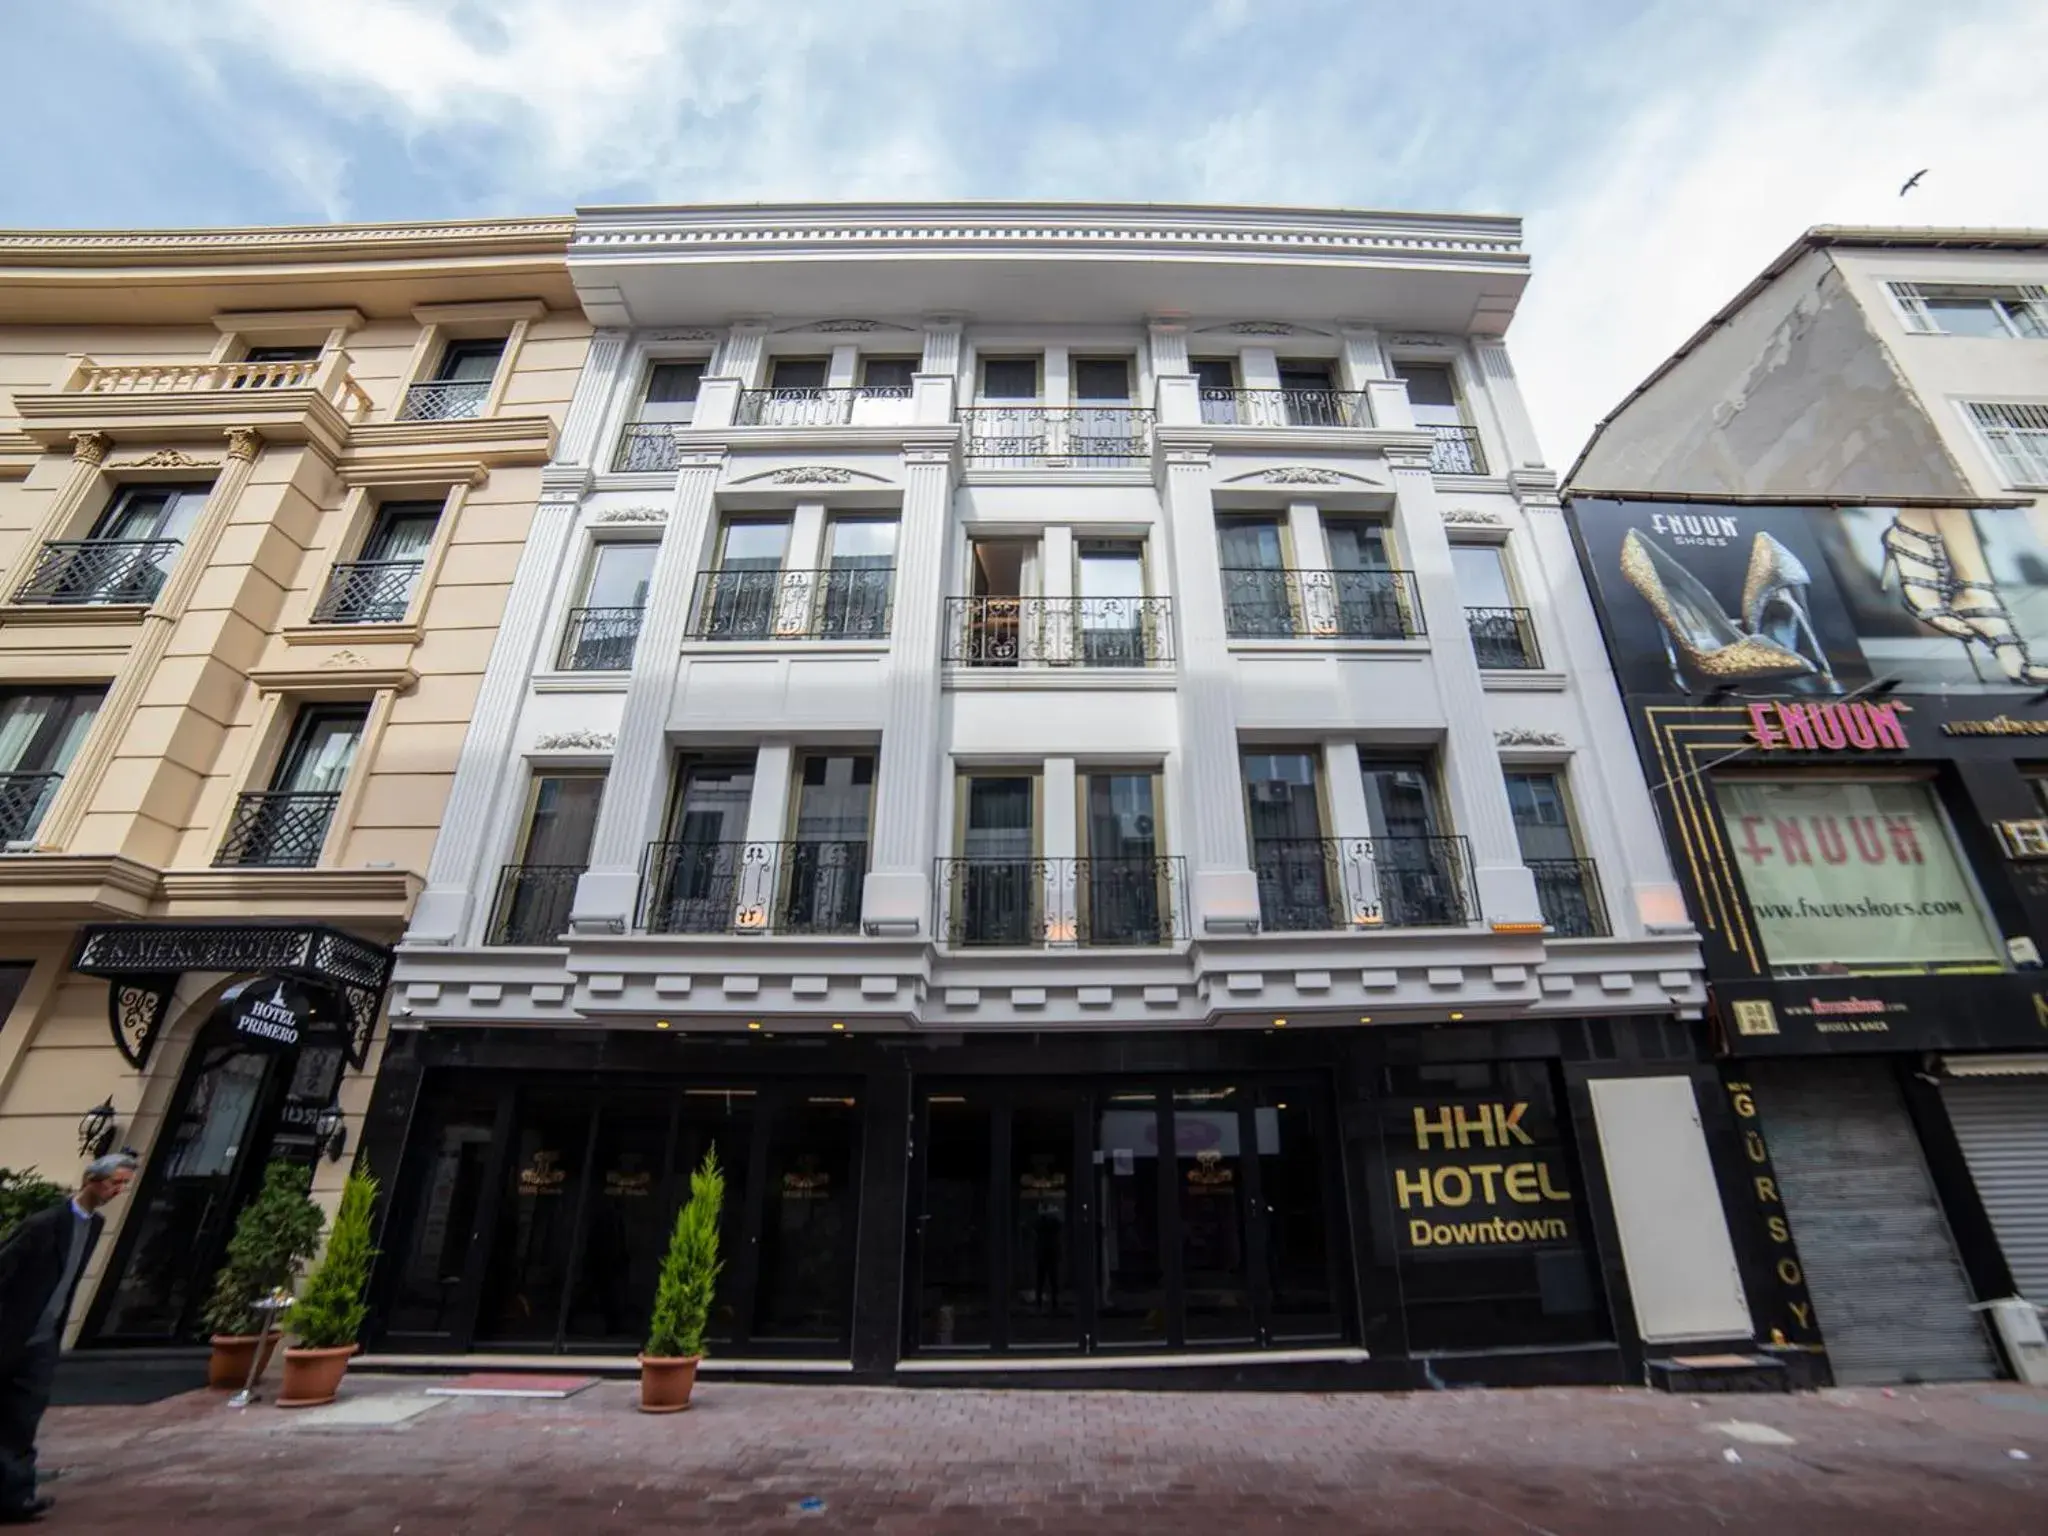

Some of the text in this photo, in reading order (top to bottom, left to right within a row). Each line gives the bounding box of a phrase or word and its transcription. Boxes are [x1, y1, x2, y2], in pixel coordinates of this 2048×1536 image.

[1673, 536, 1728, 547] SHOES
[251, 1000, 296, 1027] HOTEL
[237, 1015, 299, 1044] PRIMERO
[1413, 1103, 1536, 1150] HHK
[1395, 1162, 1572, 1209] HOTEL
[1734, 1093, 1809, 1329] GÜRSOY
[1409, 1216, 1568, 1247] Downtown
